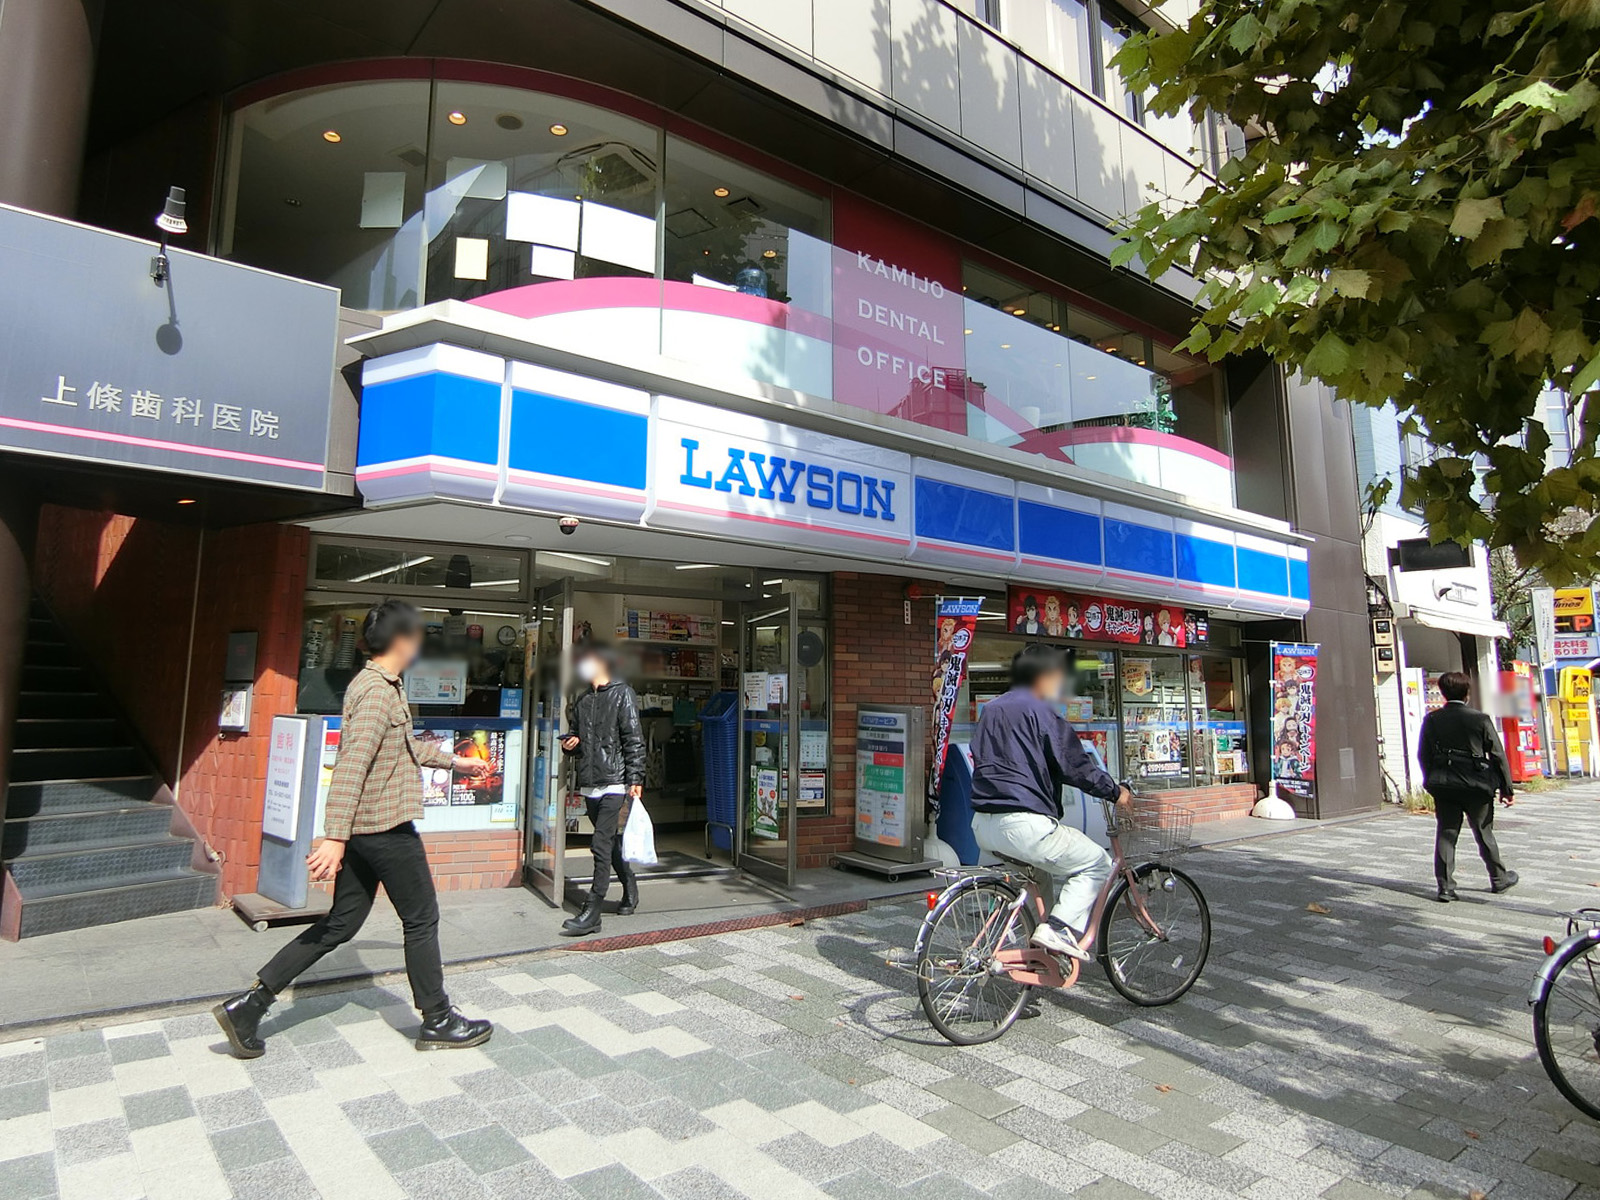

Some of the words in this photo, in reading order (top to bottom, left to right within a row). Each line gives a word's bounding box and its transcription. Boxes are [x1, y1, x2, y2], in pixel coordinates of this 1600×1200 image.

[857, 250, 944, 299] KAMIJO
[857, 298, 945, 345] DENTAL
[857, 346, 946, 390] OFFICE
[41, 375, 280, 439] 上條歯科医院
[679, 437, 896, 522] LAWSON
[940, 604, 978, 614] LAWSON
[1105, 622, 1139, 636] キャンペーン
[1276, 646, 1315, 655] LAWSON
